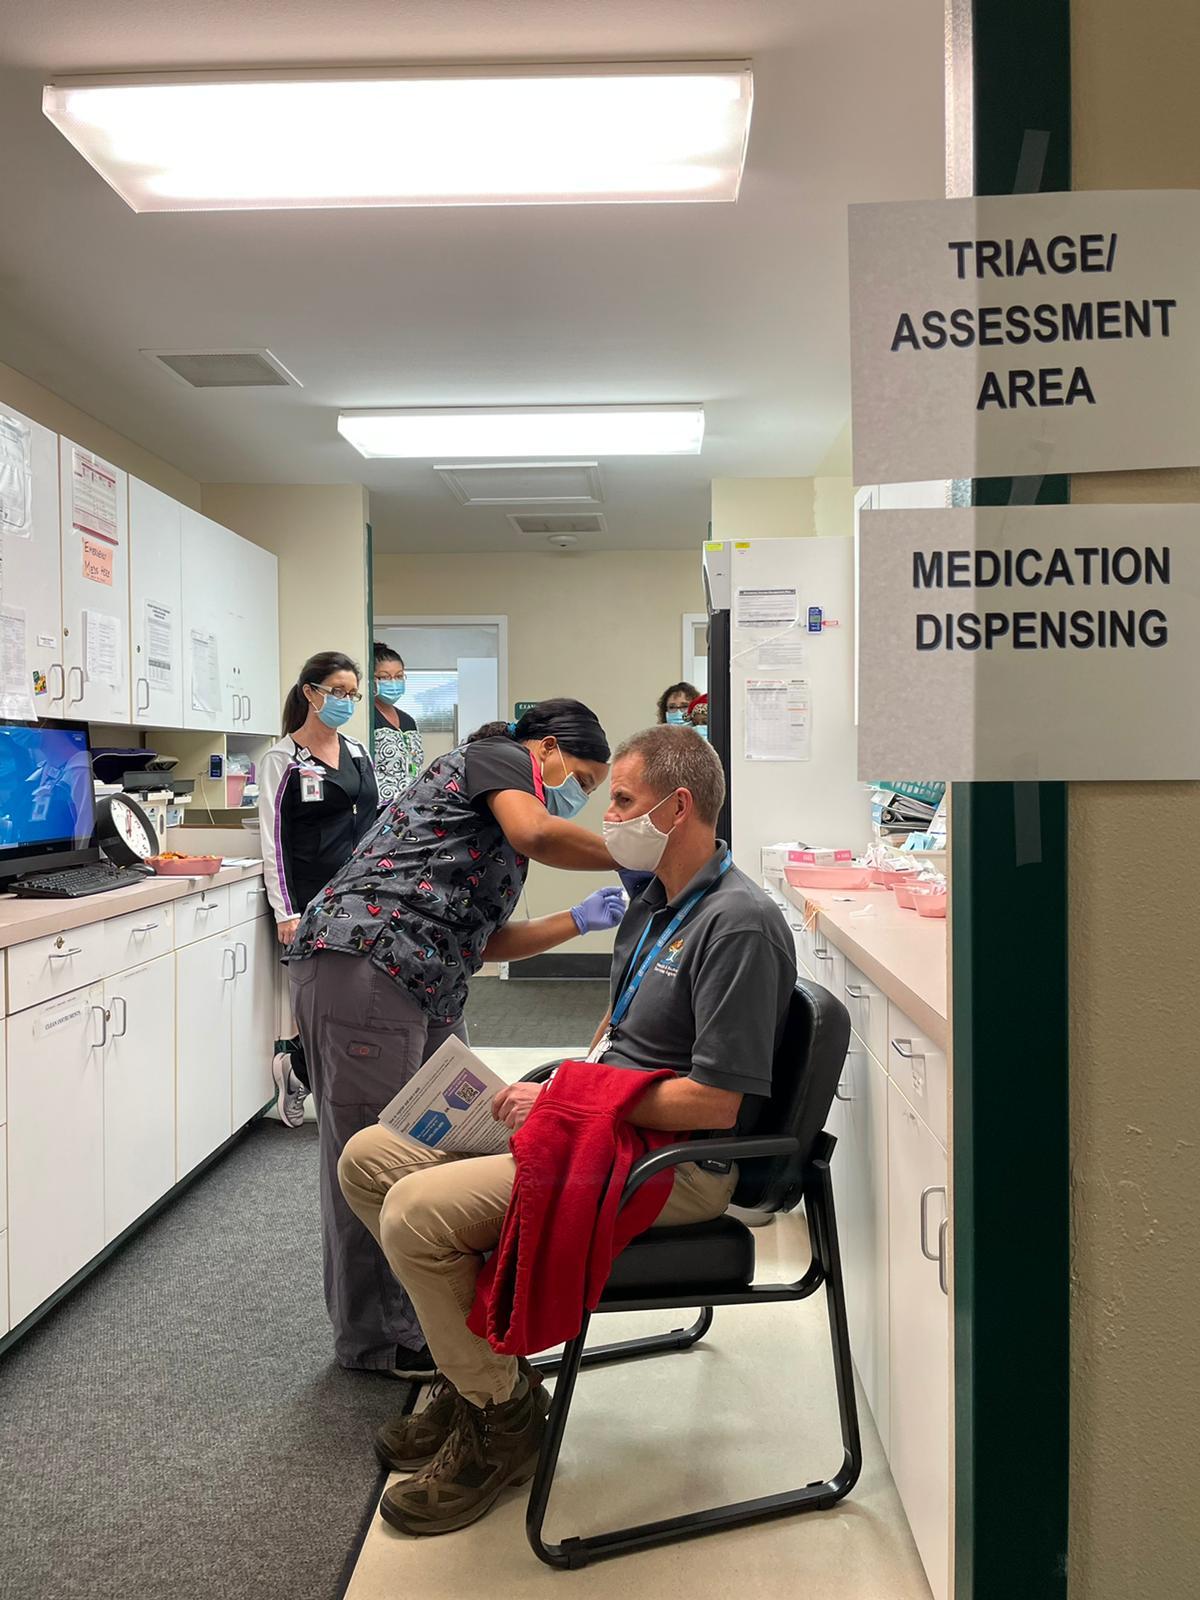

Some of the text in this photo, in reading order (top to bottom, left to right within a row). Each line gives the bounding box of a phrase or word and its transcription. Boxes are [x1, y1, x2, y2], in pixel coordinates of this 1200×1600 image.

[948, 232, 1118, 279] TRIAGE/
[890, 299, 1177, 352] ASSESSMENT
[976, 366, 1096, 411] AREA
[912, 546, 1171, 589] MEDICATION
[915, 608, 1169, 651] DISPENSING
